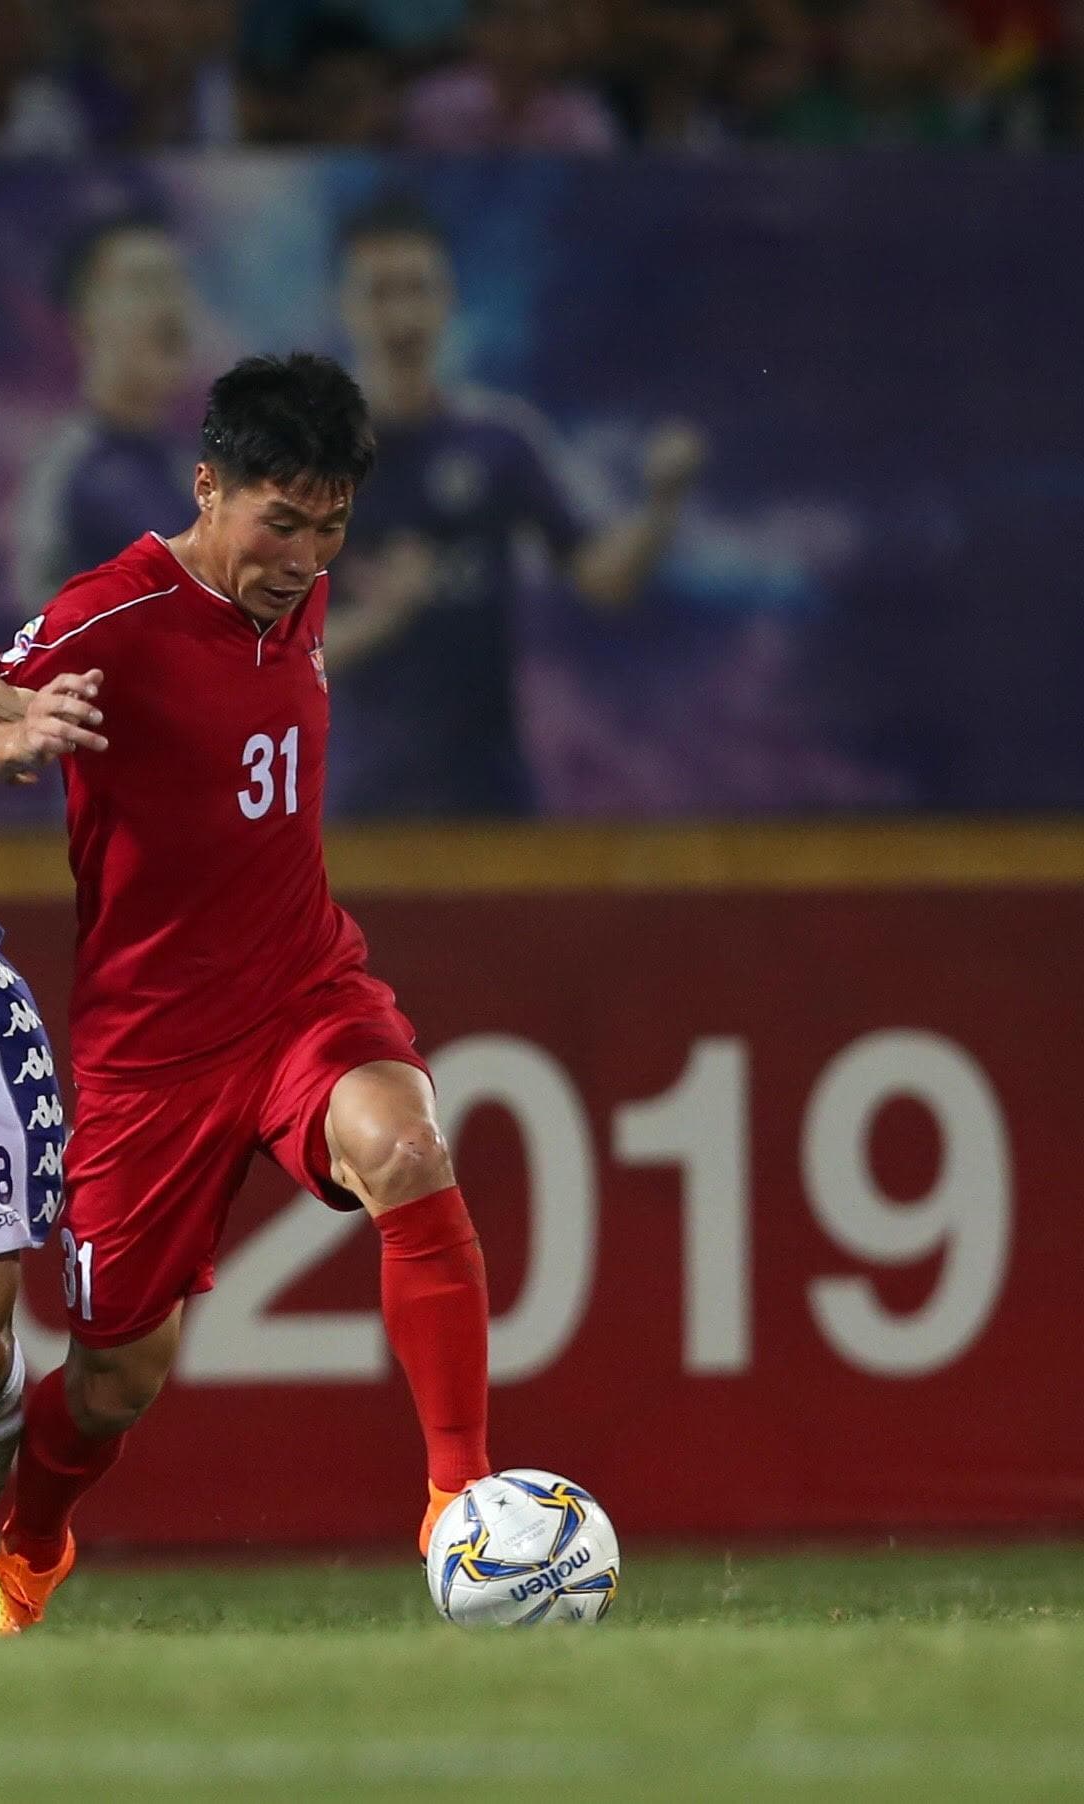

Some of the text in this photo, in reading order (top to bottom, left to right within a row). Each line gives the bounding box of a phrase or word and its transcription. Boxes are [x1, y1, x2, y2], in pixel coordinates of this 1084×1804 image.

[237, 726, 299, 820] 31
[60, 1227, 93, 1321] 31
[509, 1546, 591, 1602] molten
